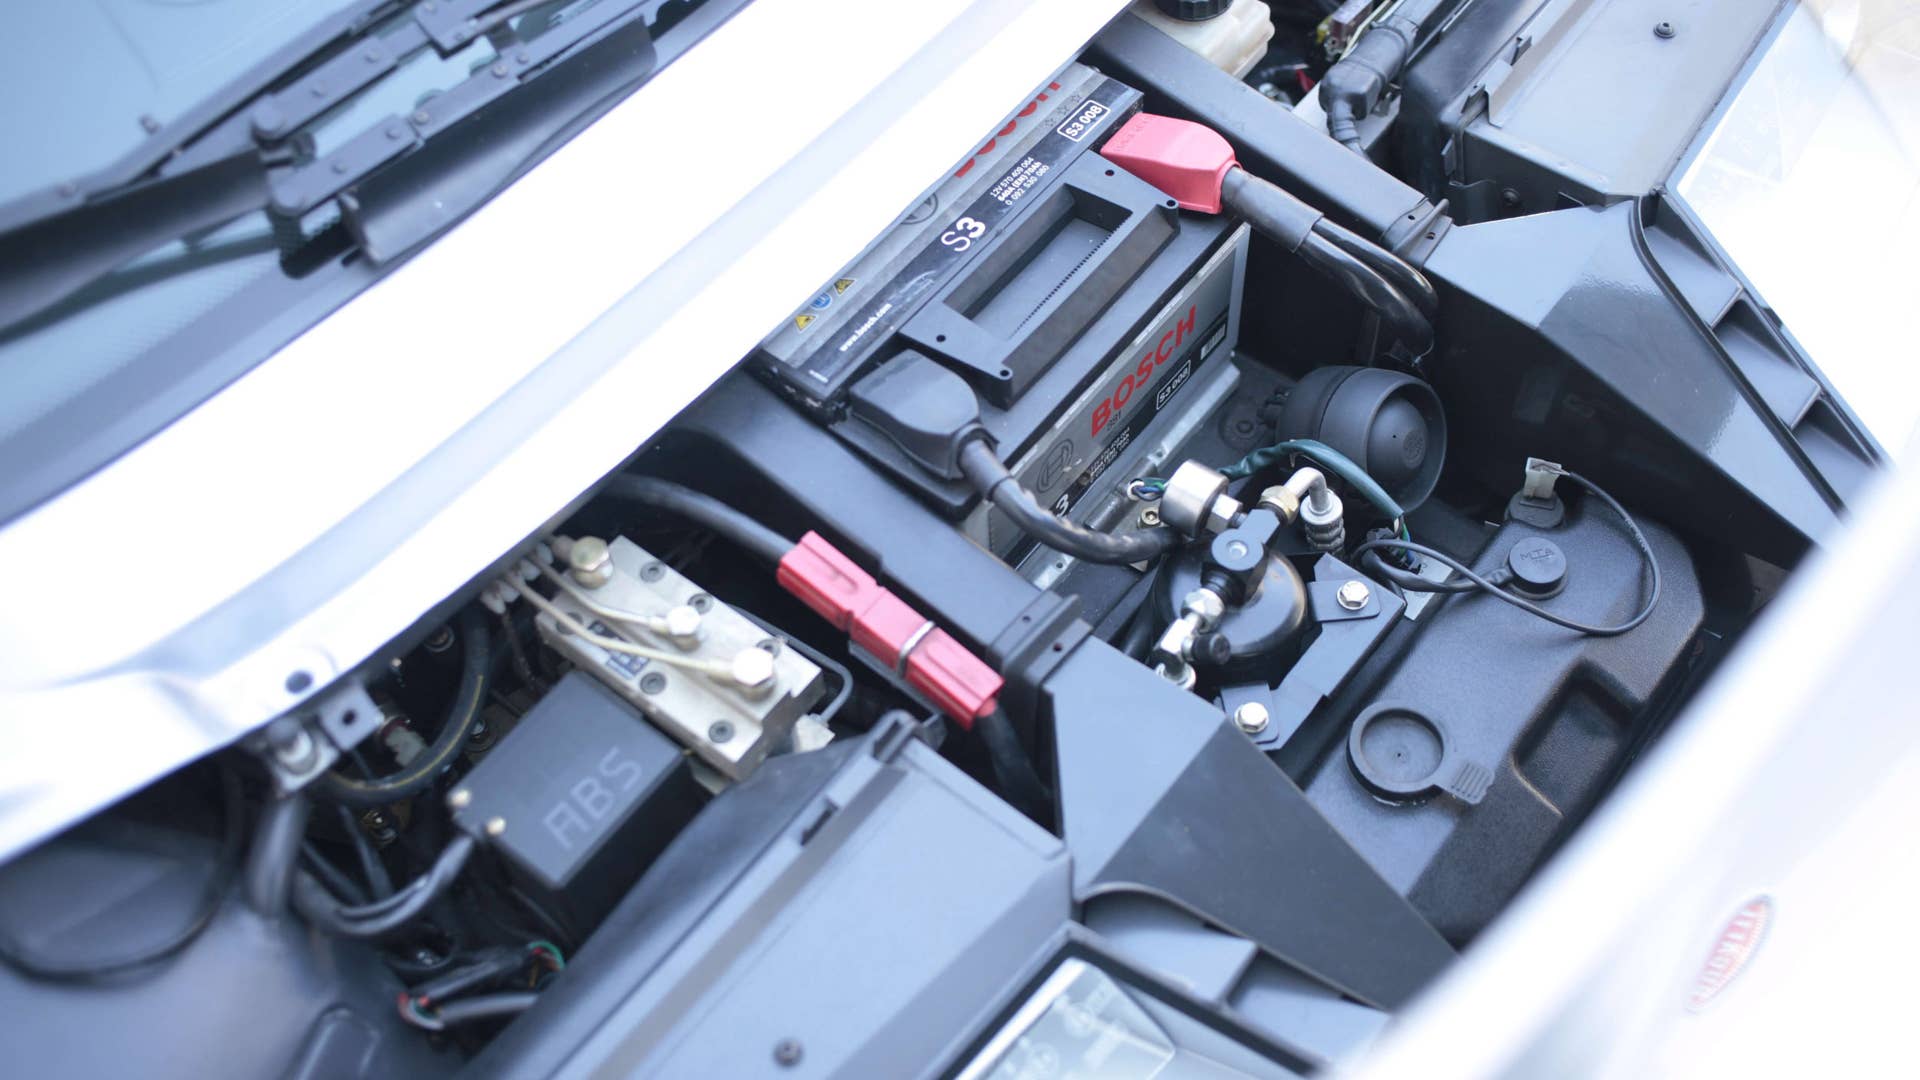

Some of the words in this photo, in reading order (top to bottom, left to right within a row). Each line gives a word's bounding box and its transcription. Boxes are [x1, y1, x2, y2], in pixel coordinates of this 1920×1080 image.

[1065, 120, 1084, 138] S3
[1081, 104, 1102, 125] 008
[941, 217, 986, 251] S3
[1090, 303, 1197, 438] BOSCH
[541, 745, 643, 850] ABS
